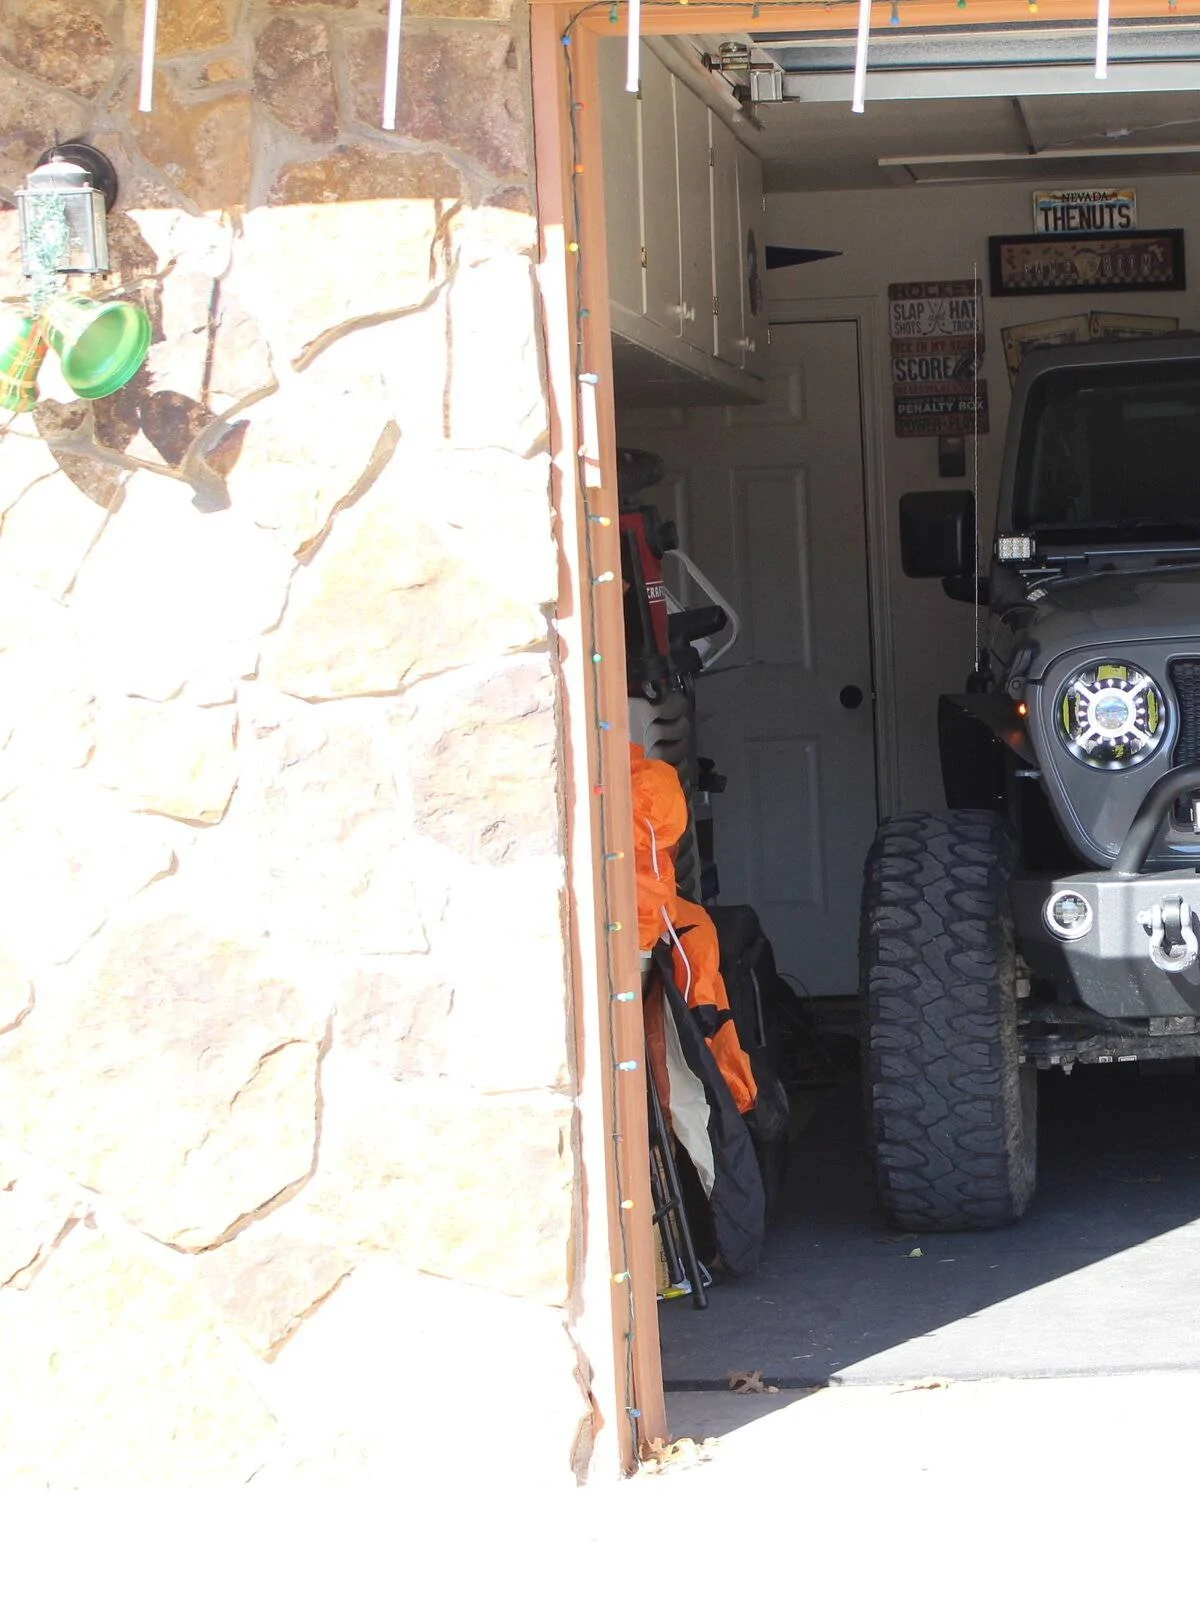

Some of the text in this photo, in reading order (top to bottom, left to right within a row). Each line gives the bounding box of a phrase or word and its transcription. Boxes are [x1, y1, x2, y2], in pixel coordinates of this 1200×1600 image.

[1062, 192, 1107, 203] NEVADA
[1040, 205, 1131, 231] THENUTS
[893, 303, 924, 321] SLAP
[949, 300, 979, 319] HAT
[895, 321, 922, 336] SHOTS
[895, 357, 952, 381] SCORE
[897, 400, 984, 414] PENALTY BOX
